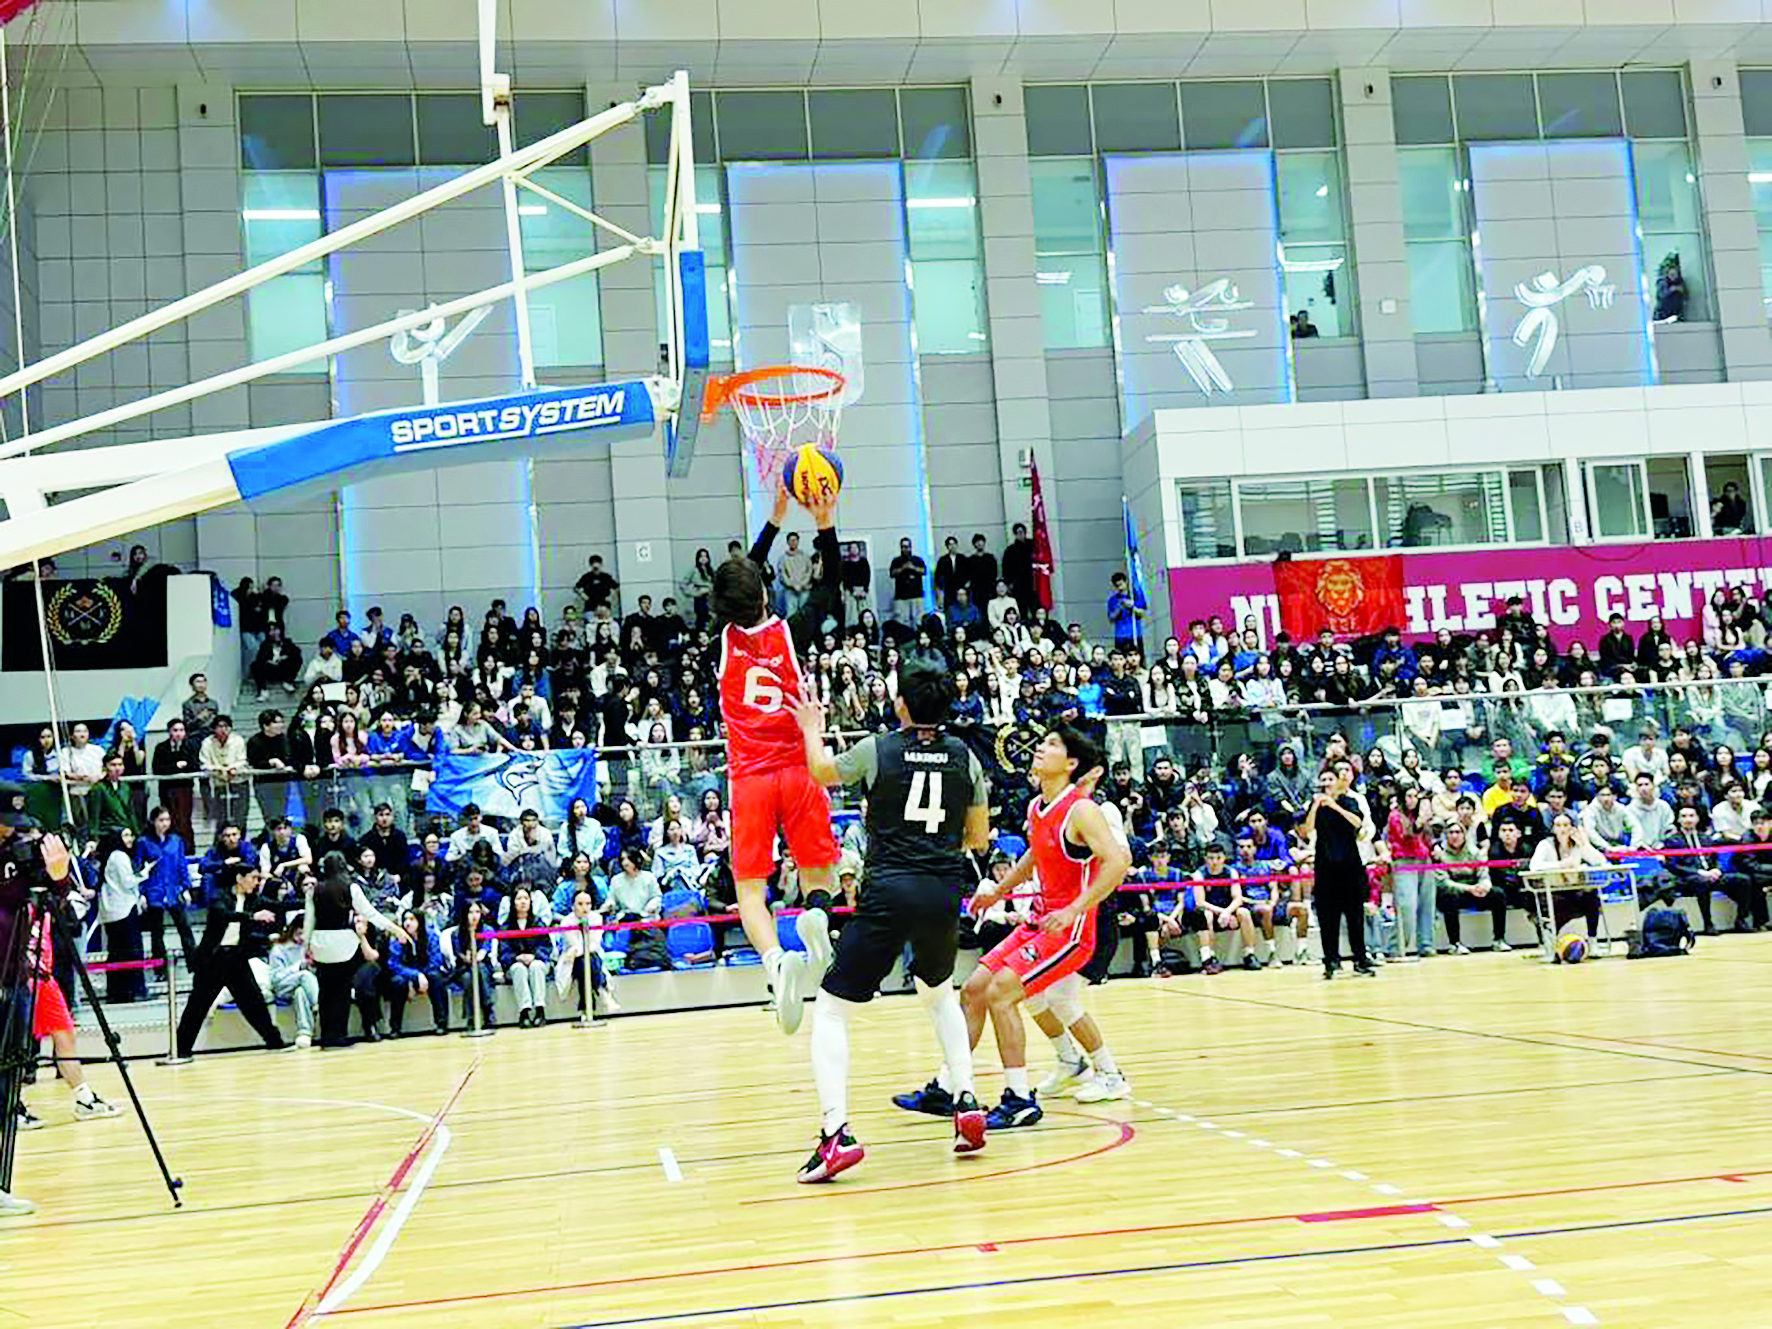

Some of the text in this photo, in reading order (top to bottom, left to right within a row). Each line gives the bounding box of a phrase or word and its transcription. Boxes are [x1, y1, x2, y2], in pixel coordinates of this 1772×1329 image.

[391, 390, 625, 444] SPORTSYSTEM
[743, 665, 784, 713] 6
[904, 770, 947, 834] 4
